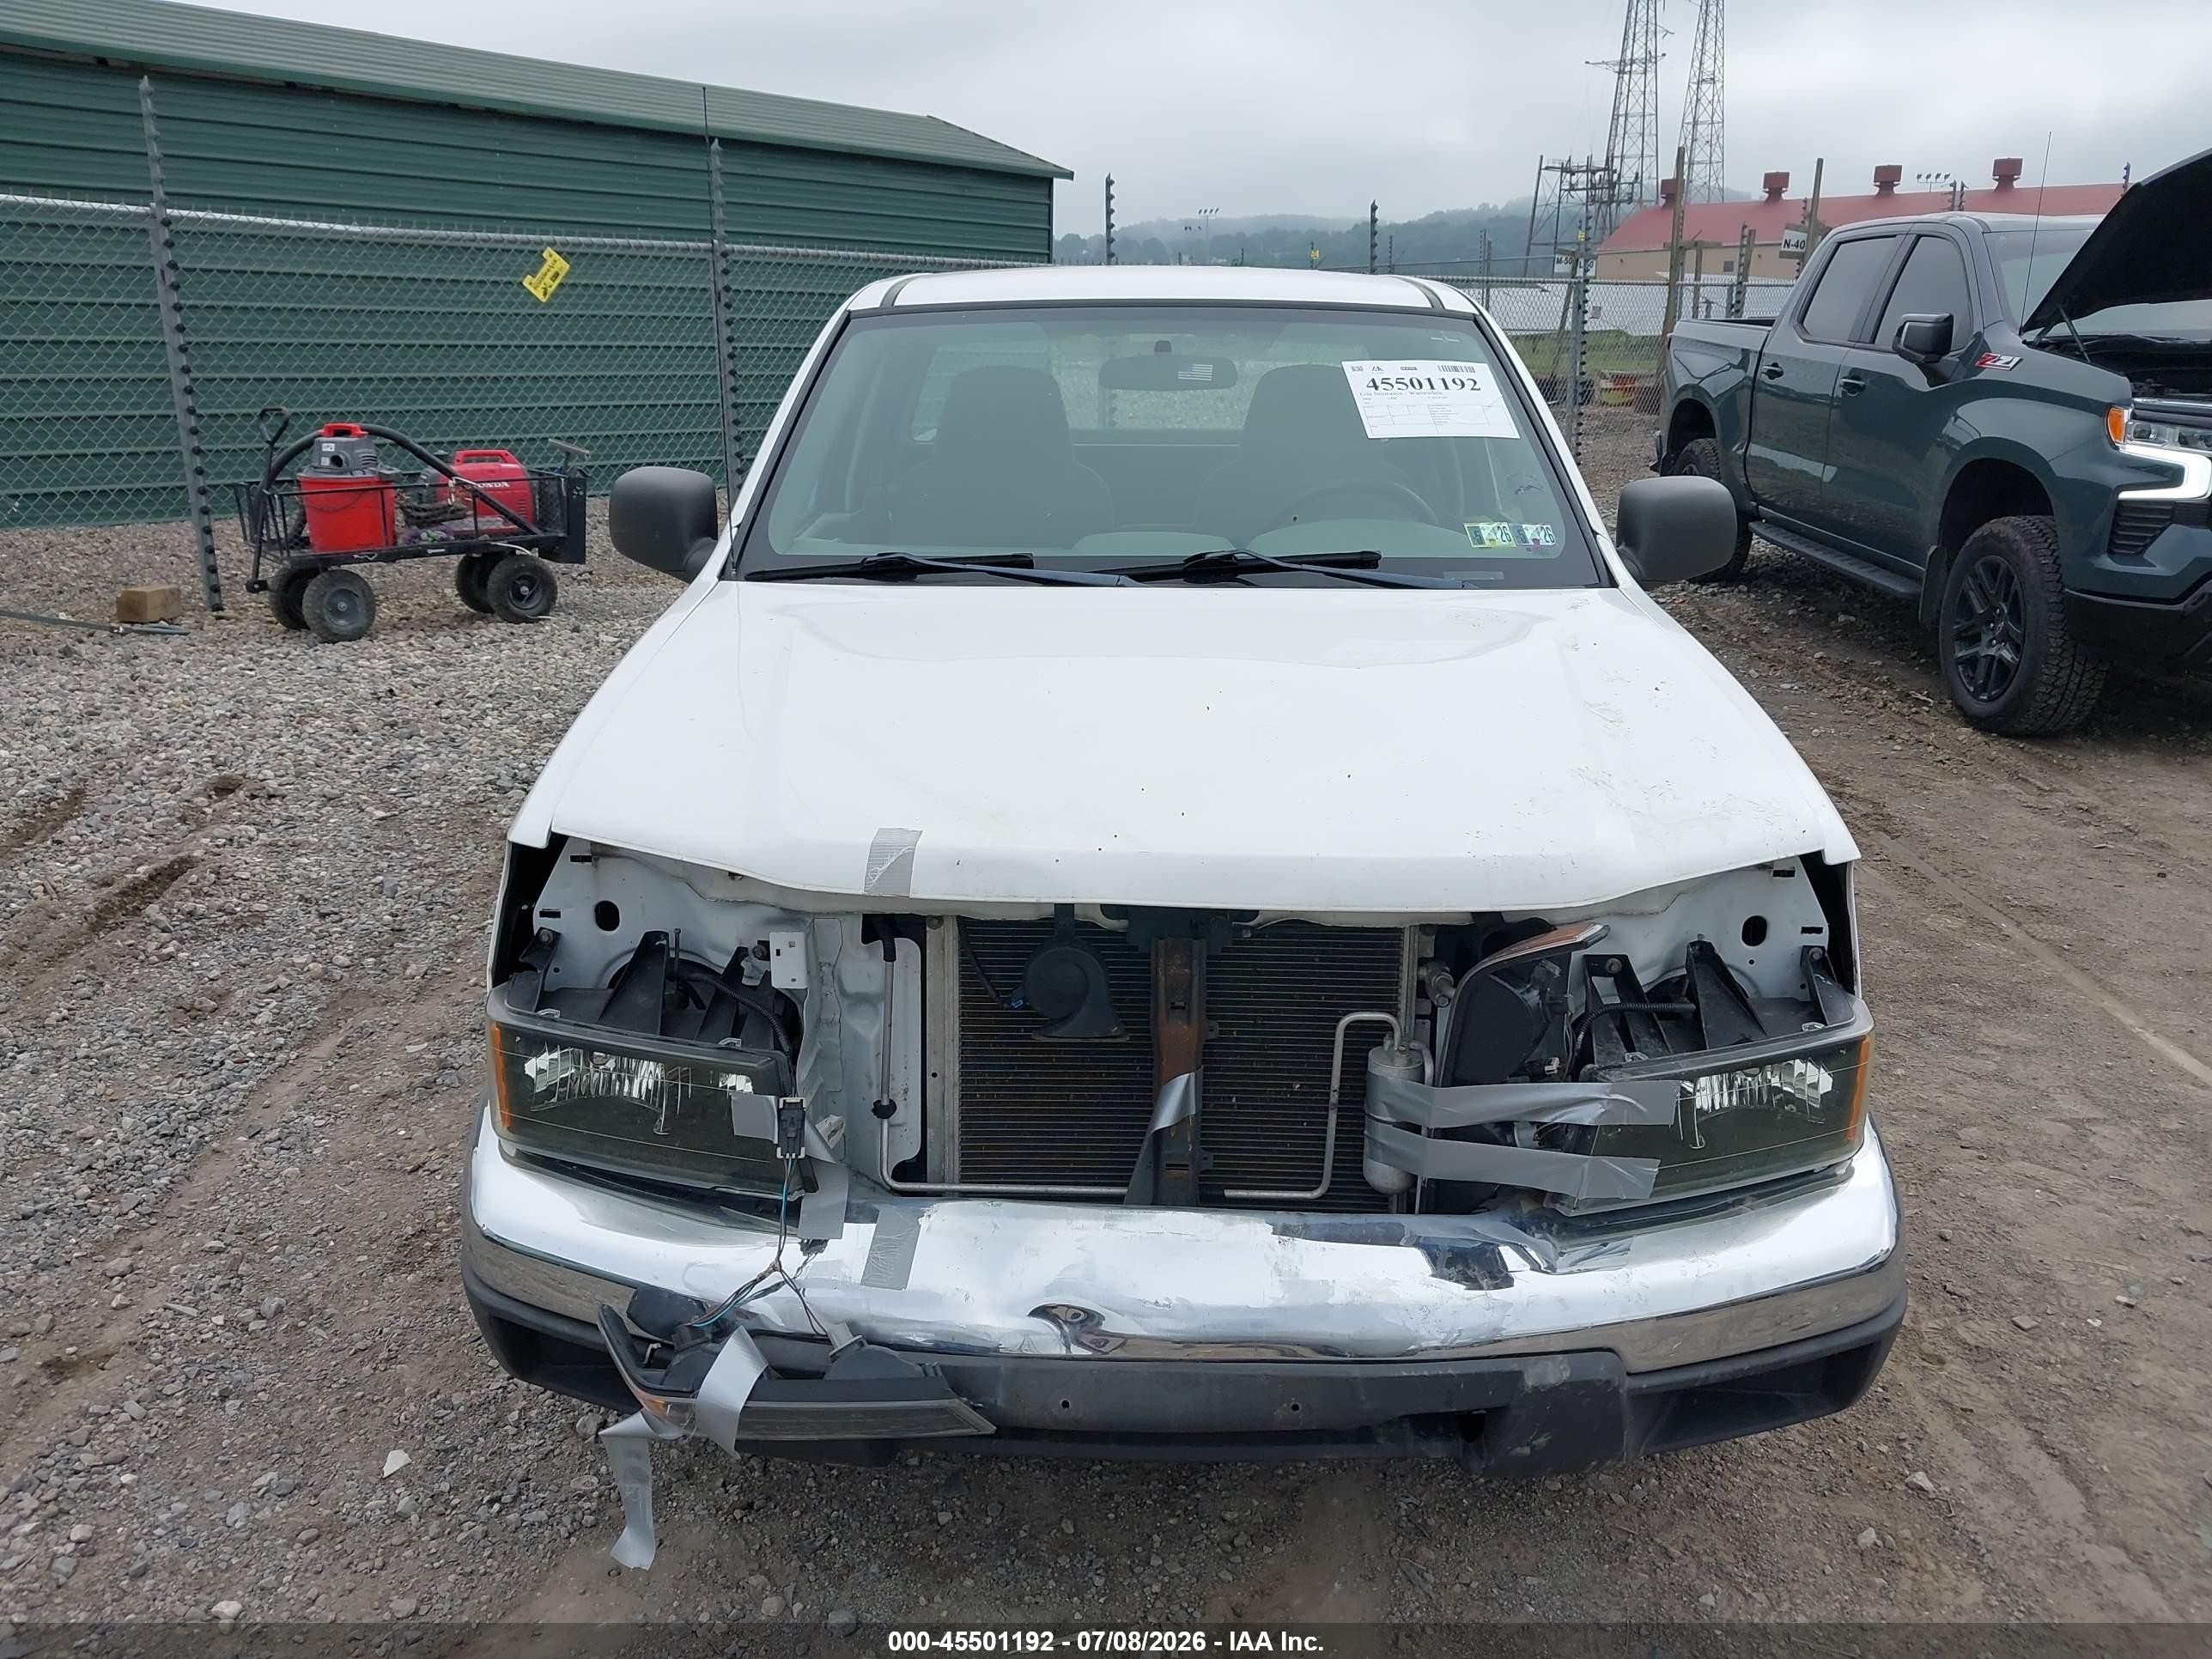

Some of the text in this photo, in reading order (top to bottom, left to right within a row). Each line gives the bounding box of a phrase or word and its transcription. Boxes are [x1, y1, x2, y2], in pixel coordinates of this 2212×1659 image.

[1783, 239, 1806, 250] N-40
[1974, 352, 2021, 371] Z71
[1366, 376, 1481, 391] 45501192
[1497, 526, 1511, 543] 26
[1540, 526, 1555, 544] 26
